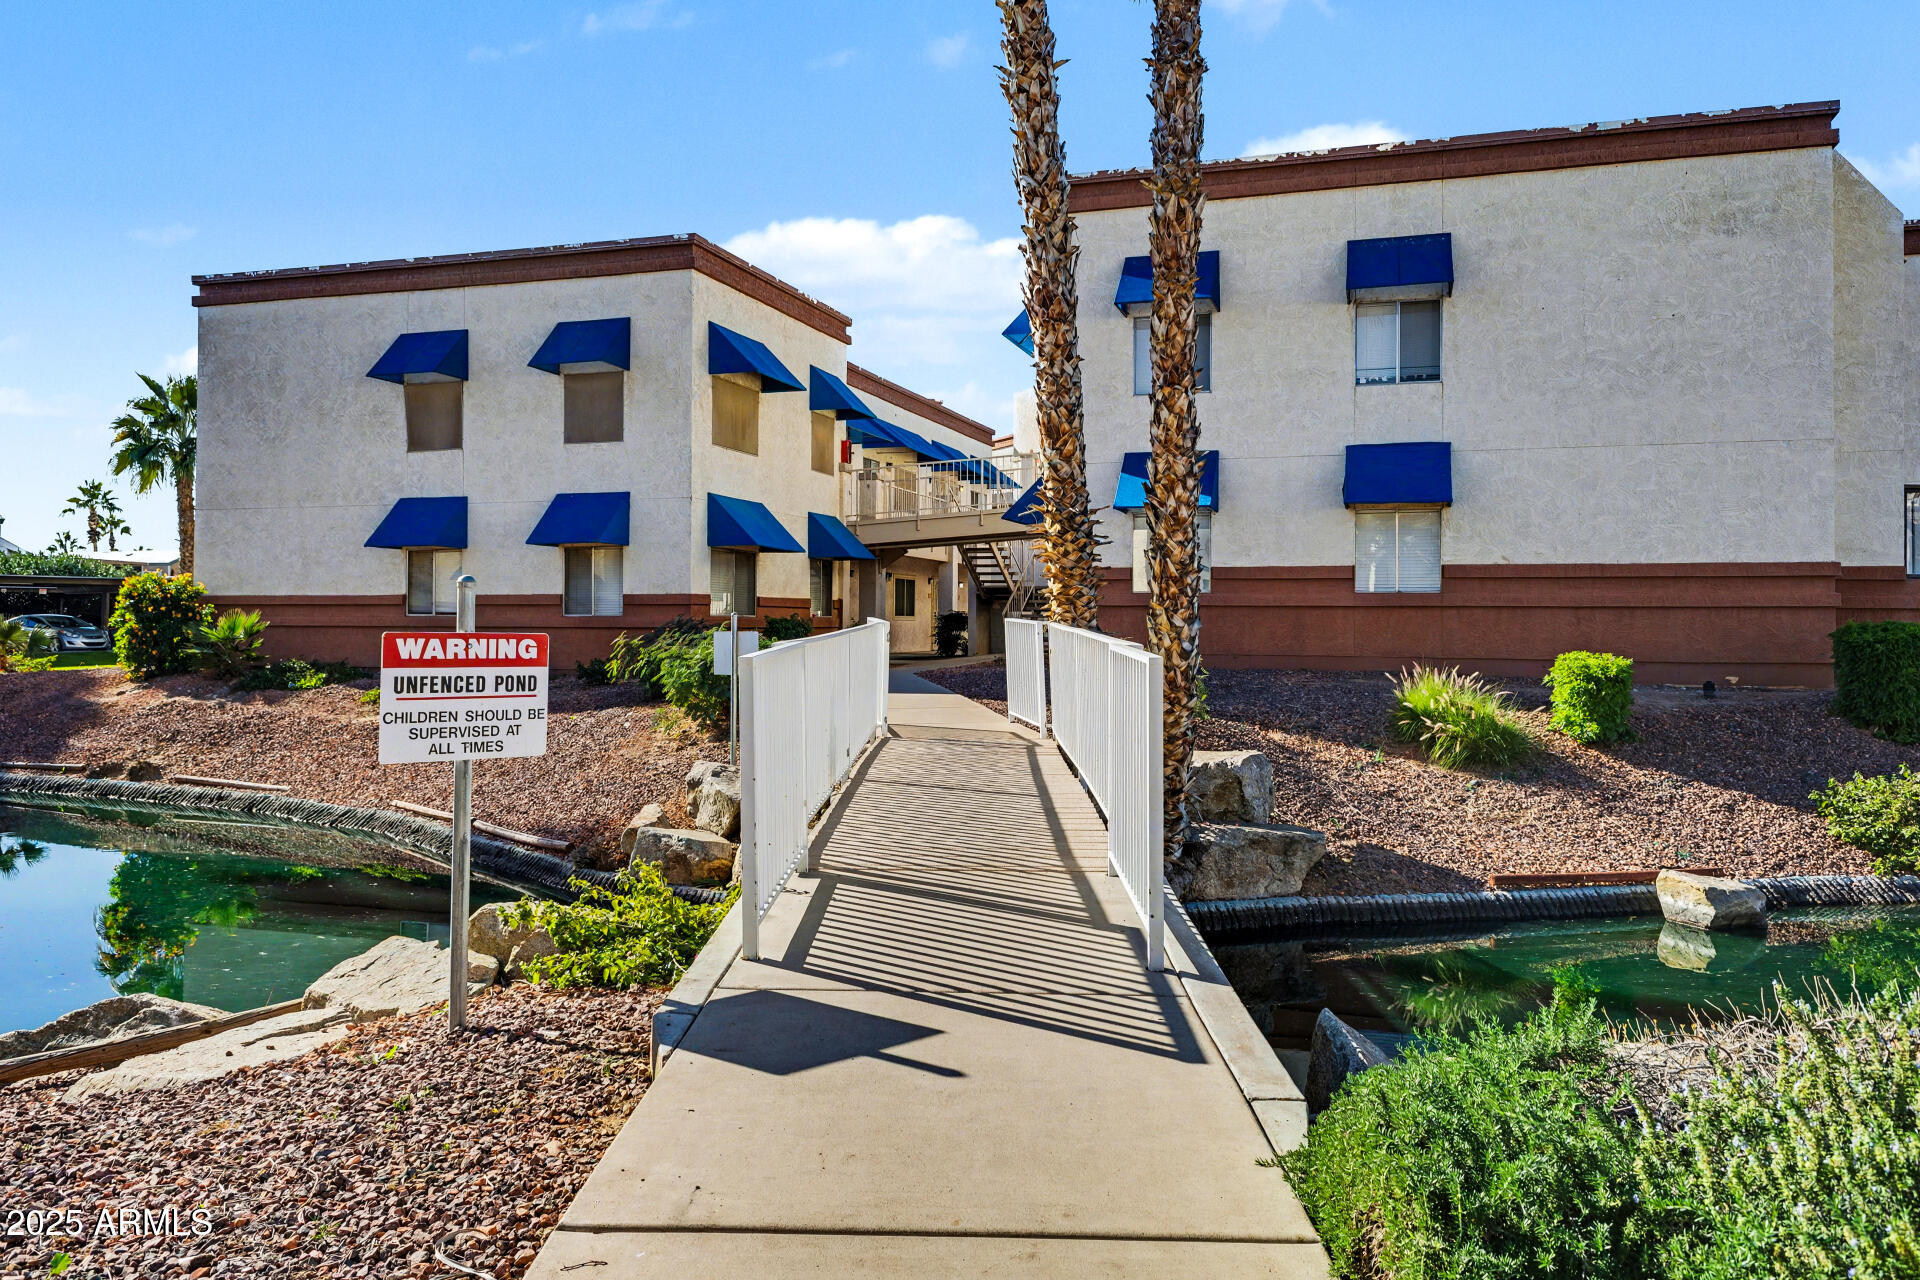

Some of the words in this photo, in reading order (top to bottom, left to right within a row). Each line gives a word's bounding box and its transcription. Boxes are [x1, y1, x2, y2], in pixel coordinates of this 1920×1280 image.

[396, 638, 538, 660] WARNING
[393, 675, 486, 694] UNFENCED
[494, 675, 538, 692] POND
[382, 711, 458, 724] CHILDREN
[465, 709, 522, 722] SHOULD
[528, 708, 546, 720] BE
[408, 726, 500, 740] SUPERVISED
[506, 724, 522, 736] AT
[428, 742, 455, 755] ALL
[461, 740, 504, 753] TIMES
